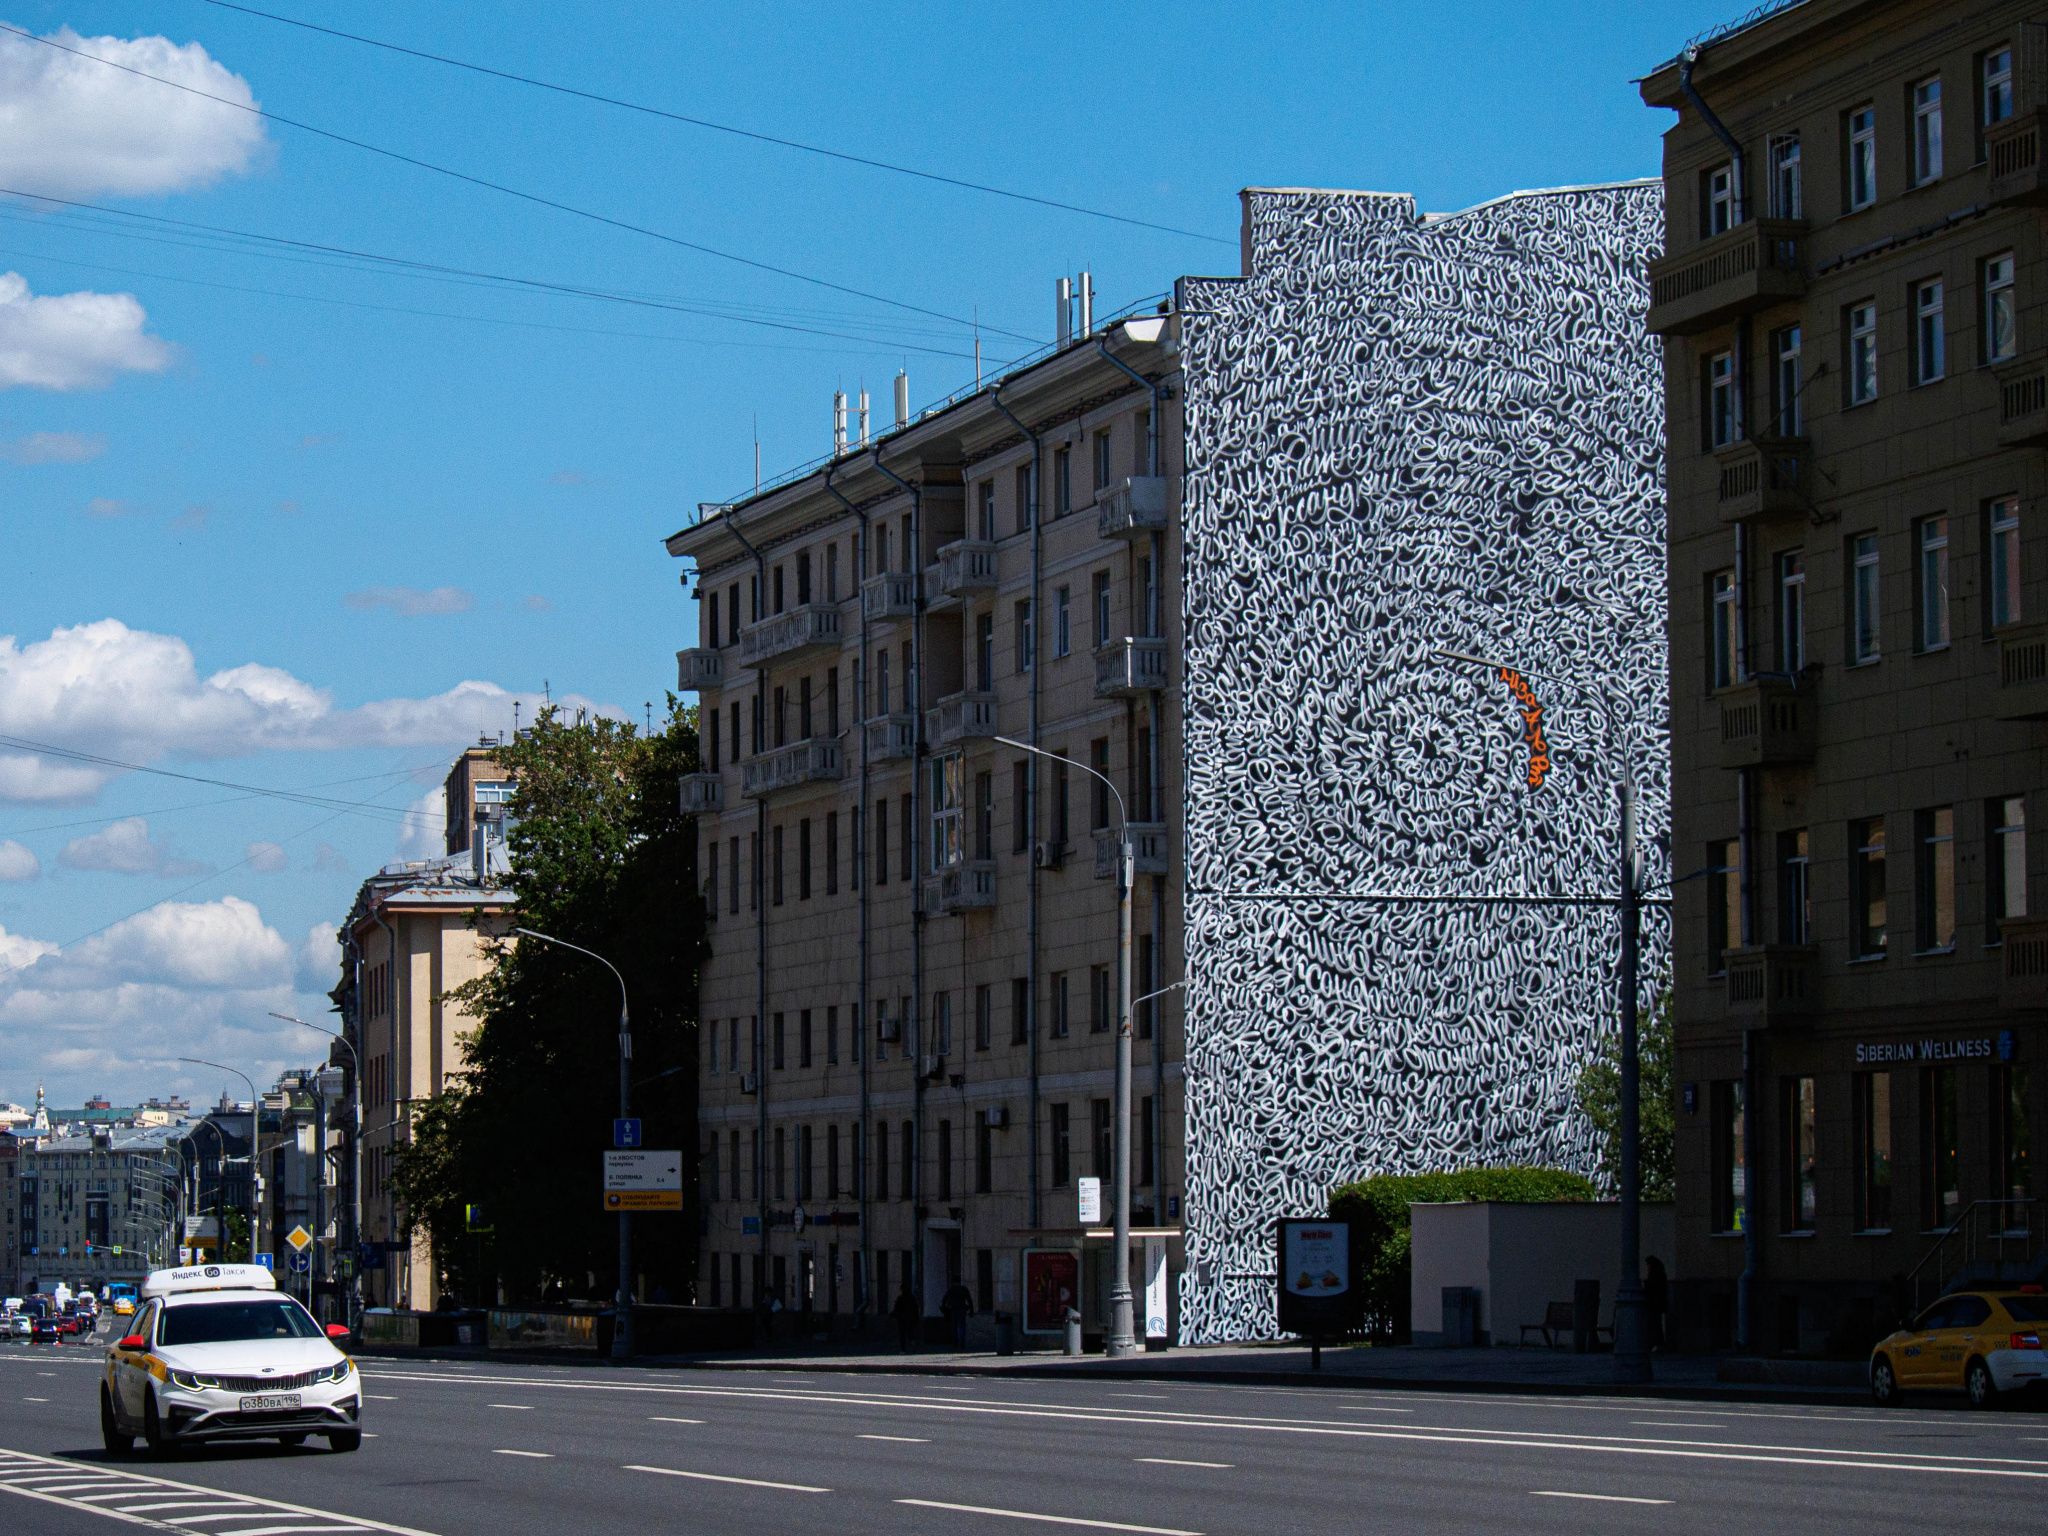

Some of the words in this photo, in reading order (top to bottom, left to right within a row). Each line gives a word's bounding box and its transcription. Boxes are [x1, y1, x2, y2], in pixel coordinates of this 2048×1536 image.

[171, 1269, 203, 1281] Яндекс
[205, 1267, 220, 1277] Go
[222, 1267, 246, 1276] Такси
